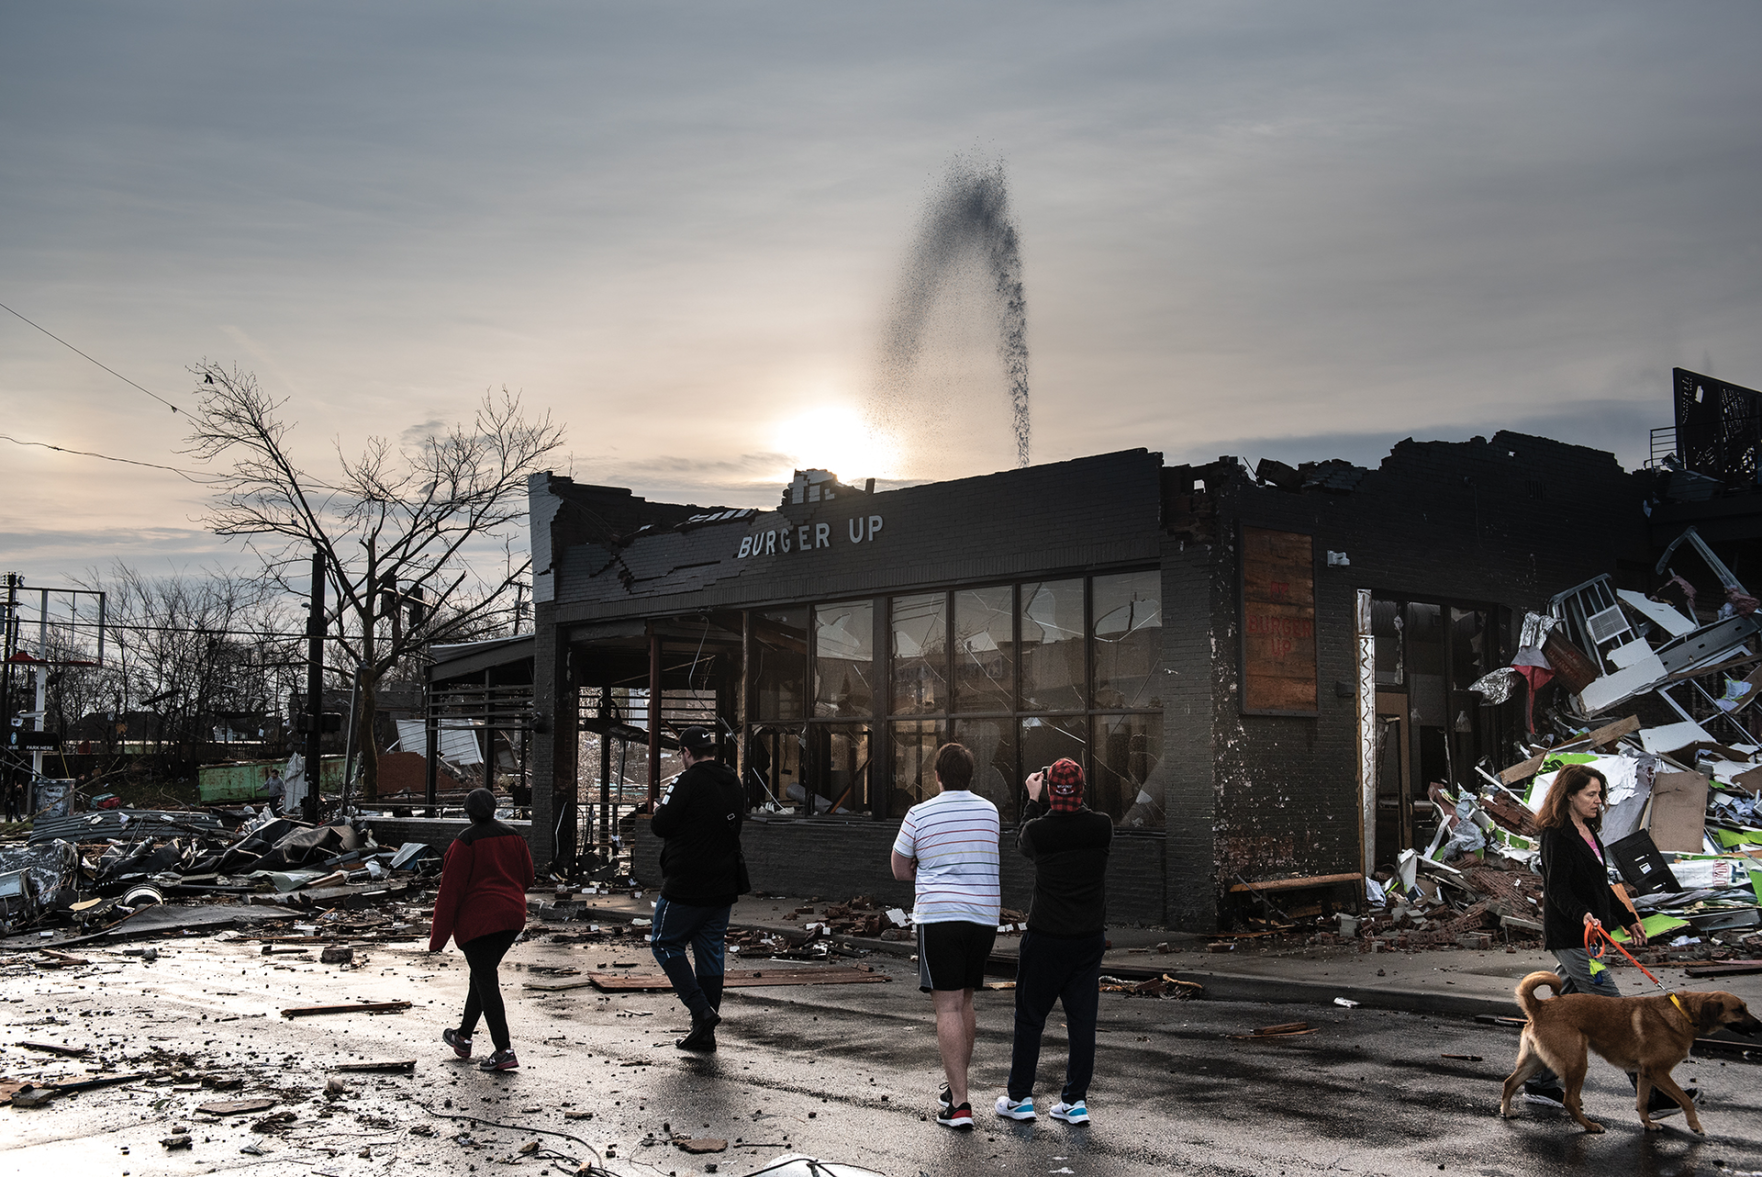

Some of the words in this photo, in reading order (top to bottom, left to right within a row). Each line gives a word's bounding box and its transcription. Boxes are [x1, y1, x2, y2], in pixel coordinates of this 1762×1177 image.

[737, 522, 830, 559] BURGER
[849, 515, 883, 544] UP
[1248, 614, 1311, 638] BURGER
[1271, 638, 1291, 657] UP
